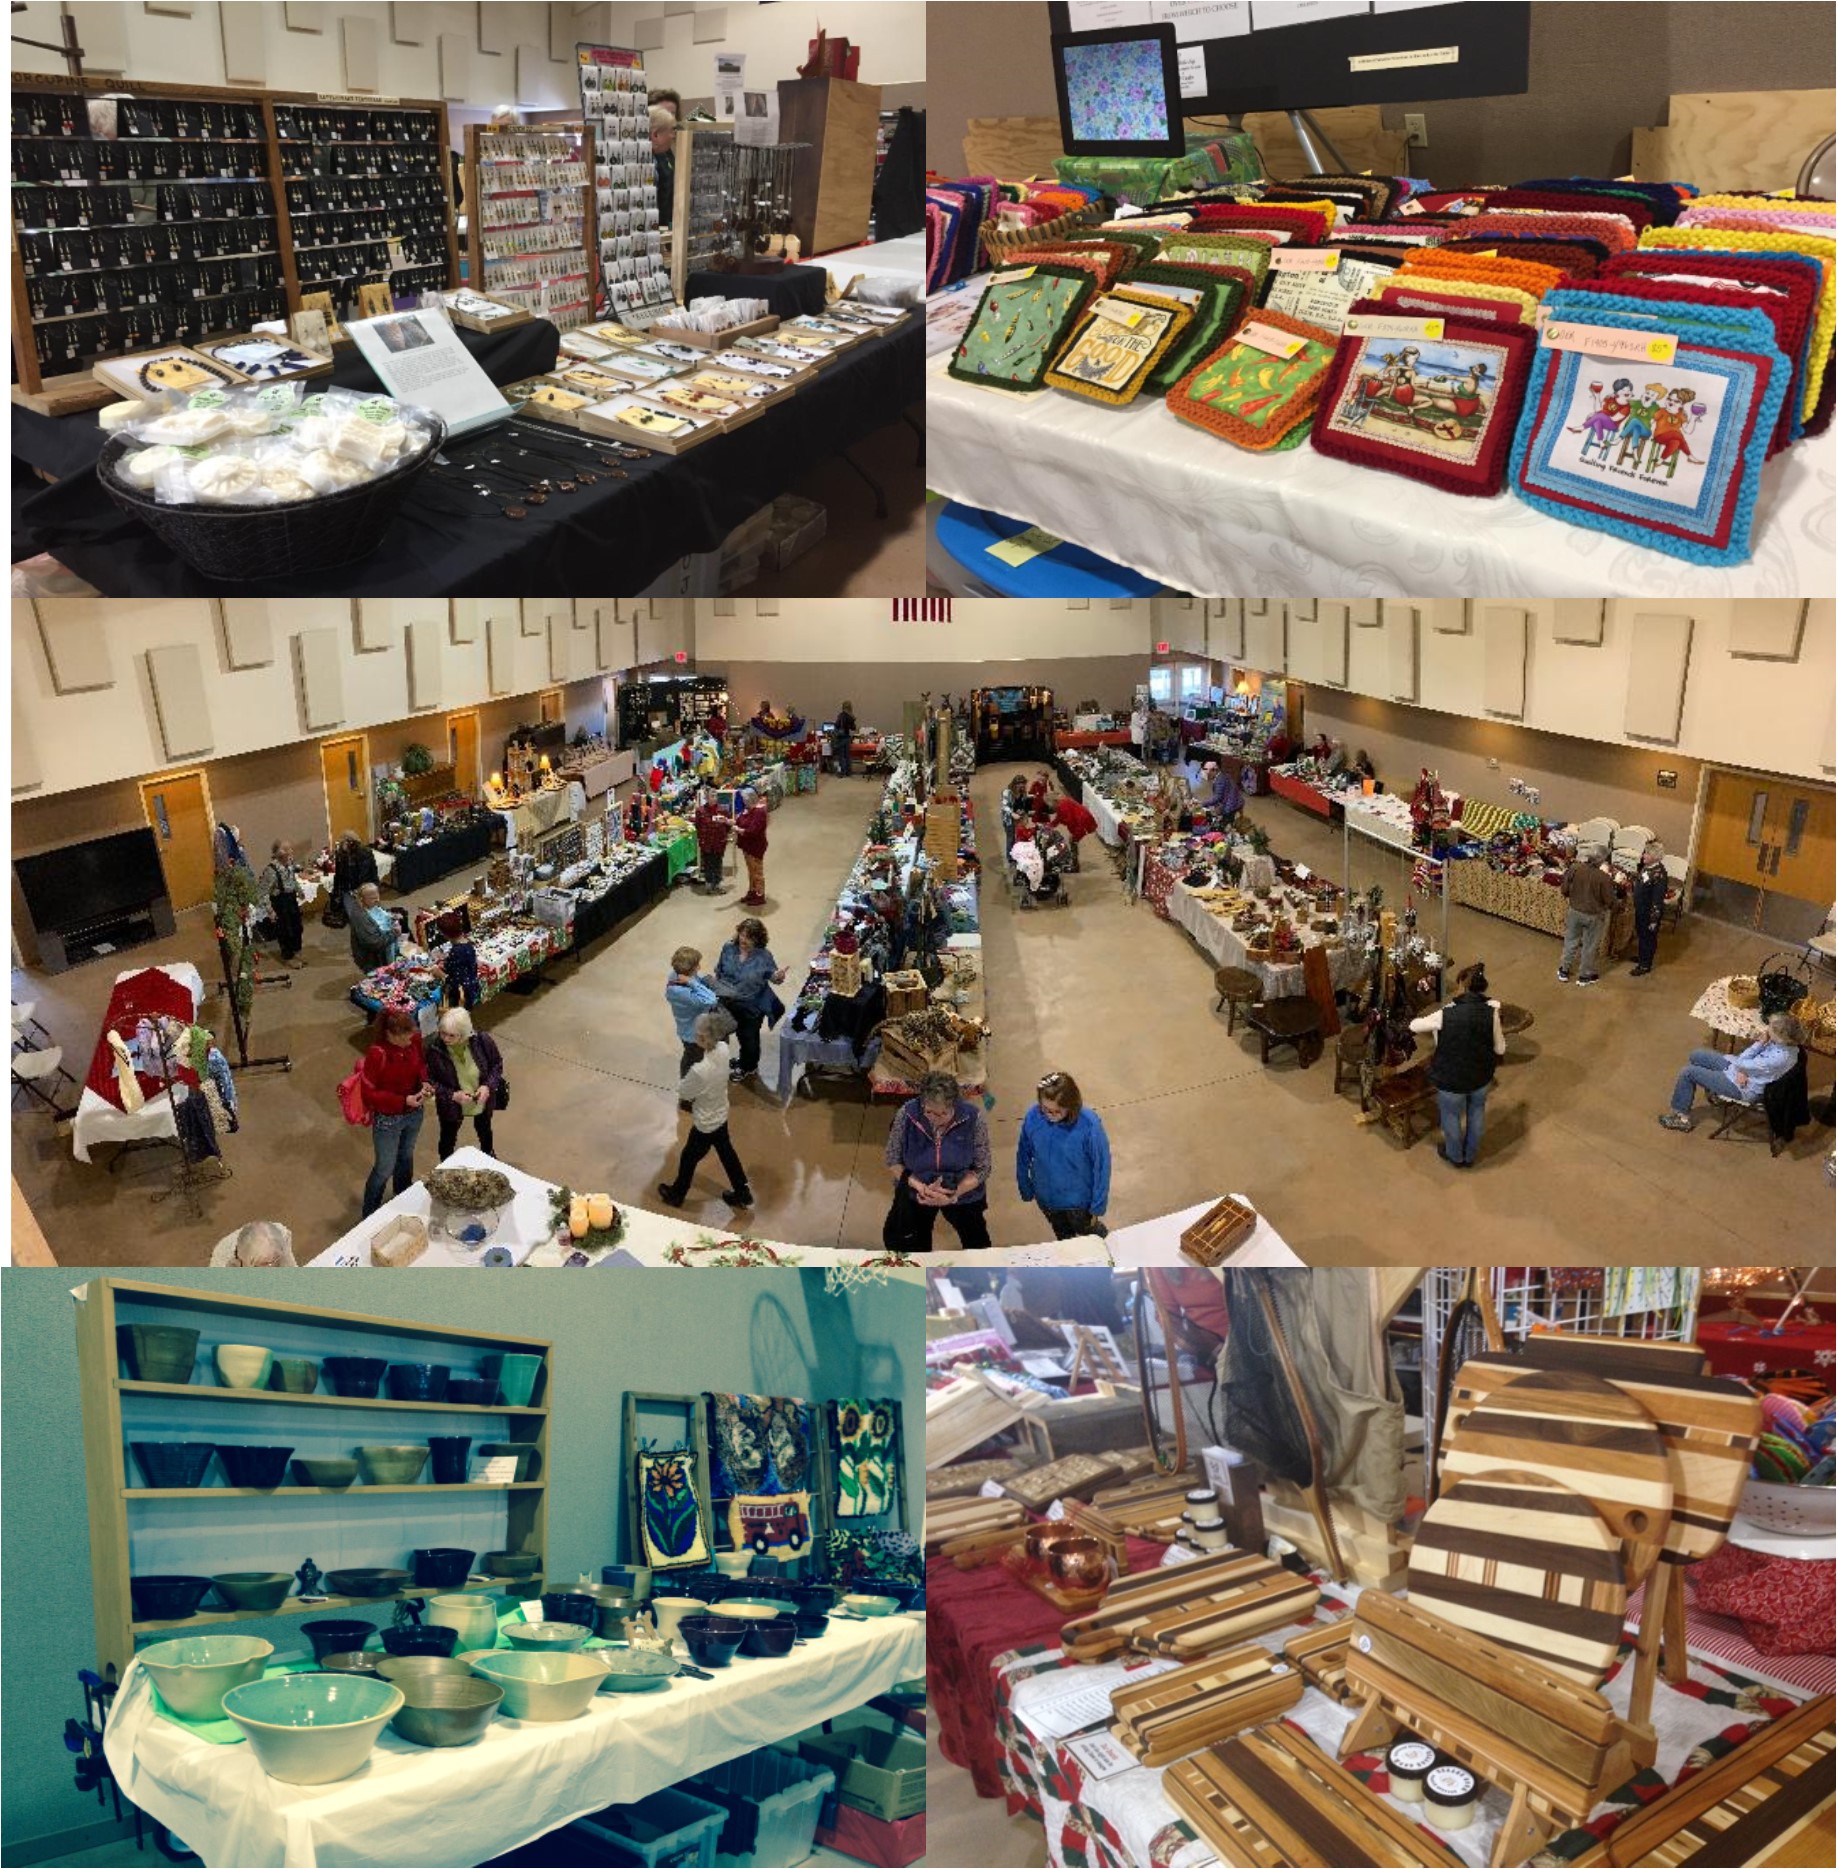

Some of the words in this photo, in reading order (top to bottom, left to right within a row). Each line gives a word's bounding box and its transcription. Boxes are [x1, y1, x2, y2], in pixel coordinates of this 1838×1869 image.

[12, 71, 89, 88] ORCUPINE
[104, 78, 145, 91] QUILL
[1064, 338, 1140, 384] GOOD
